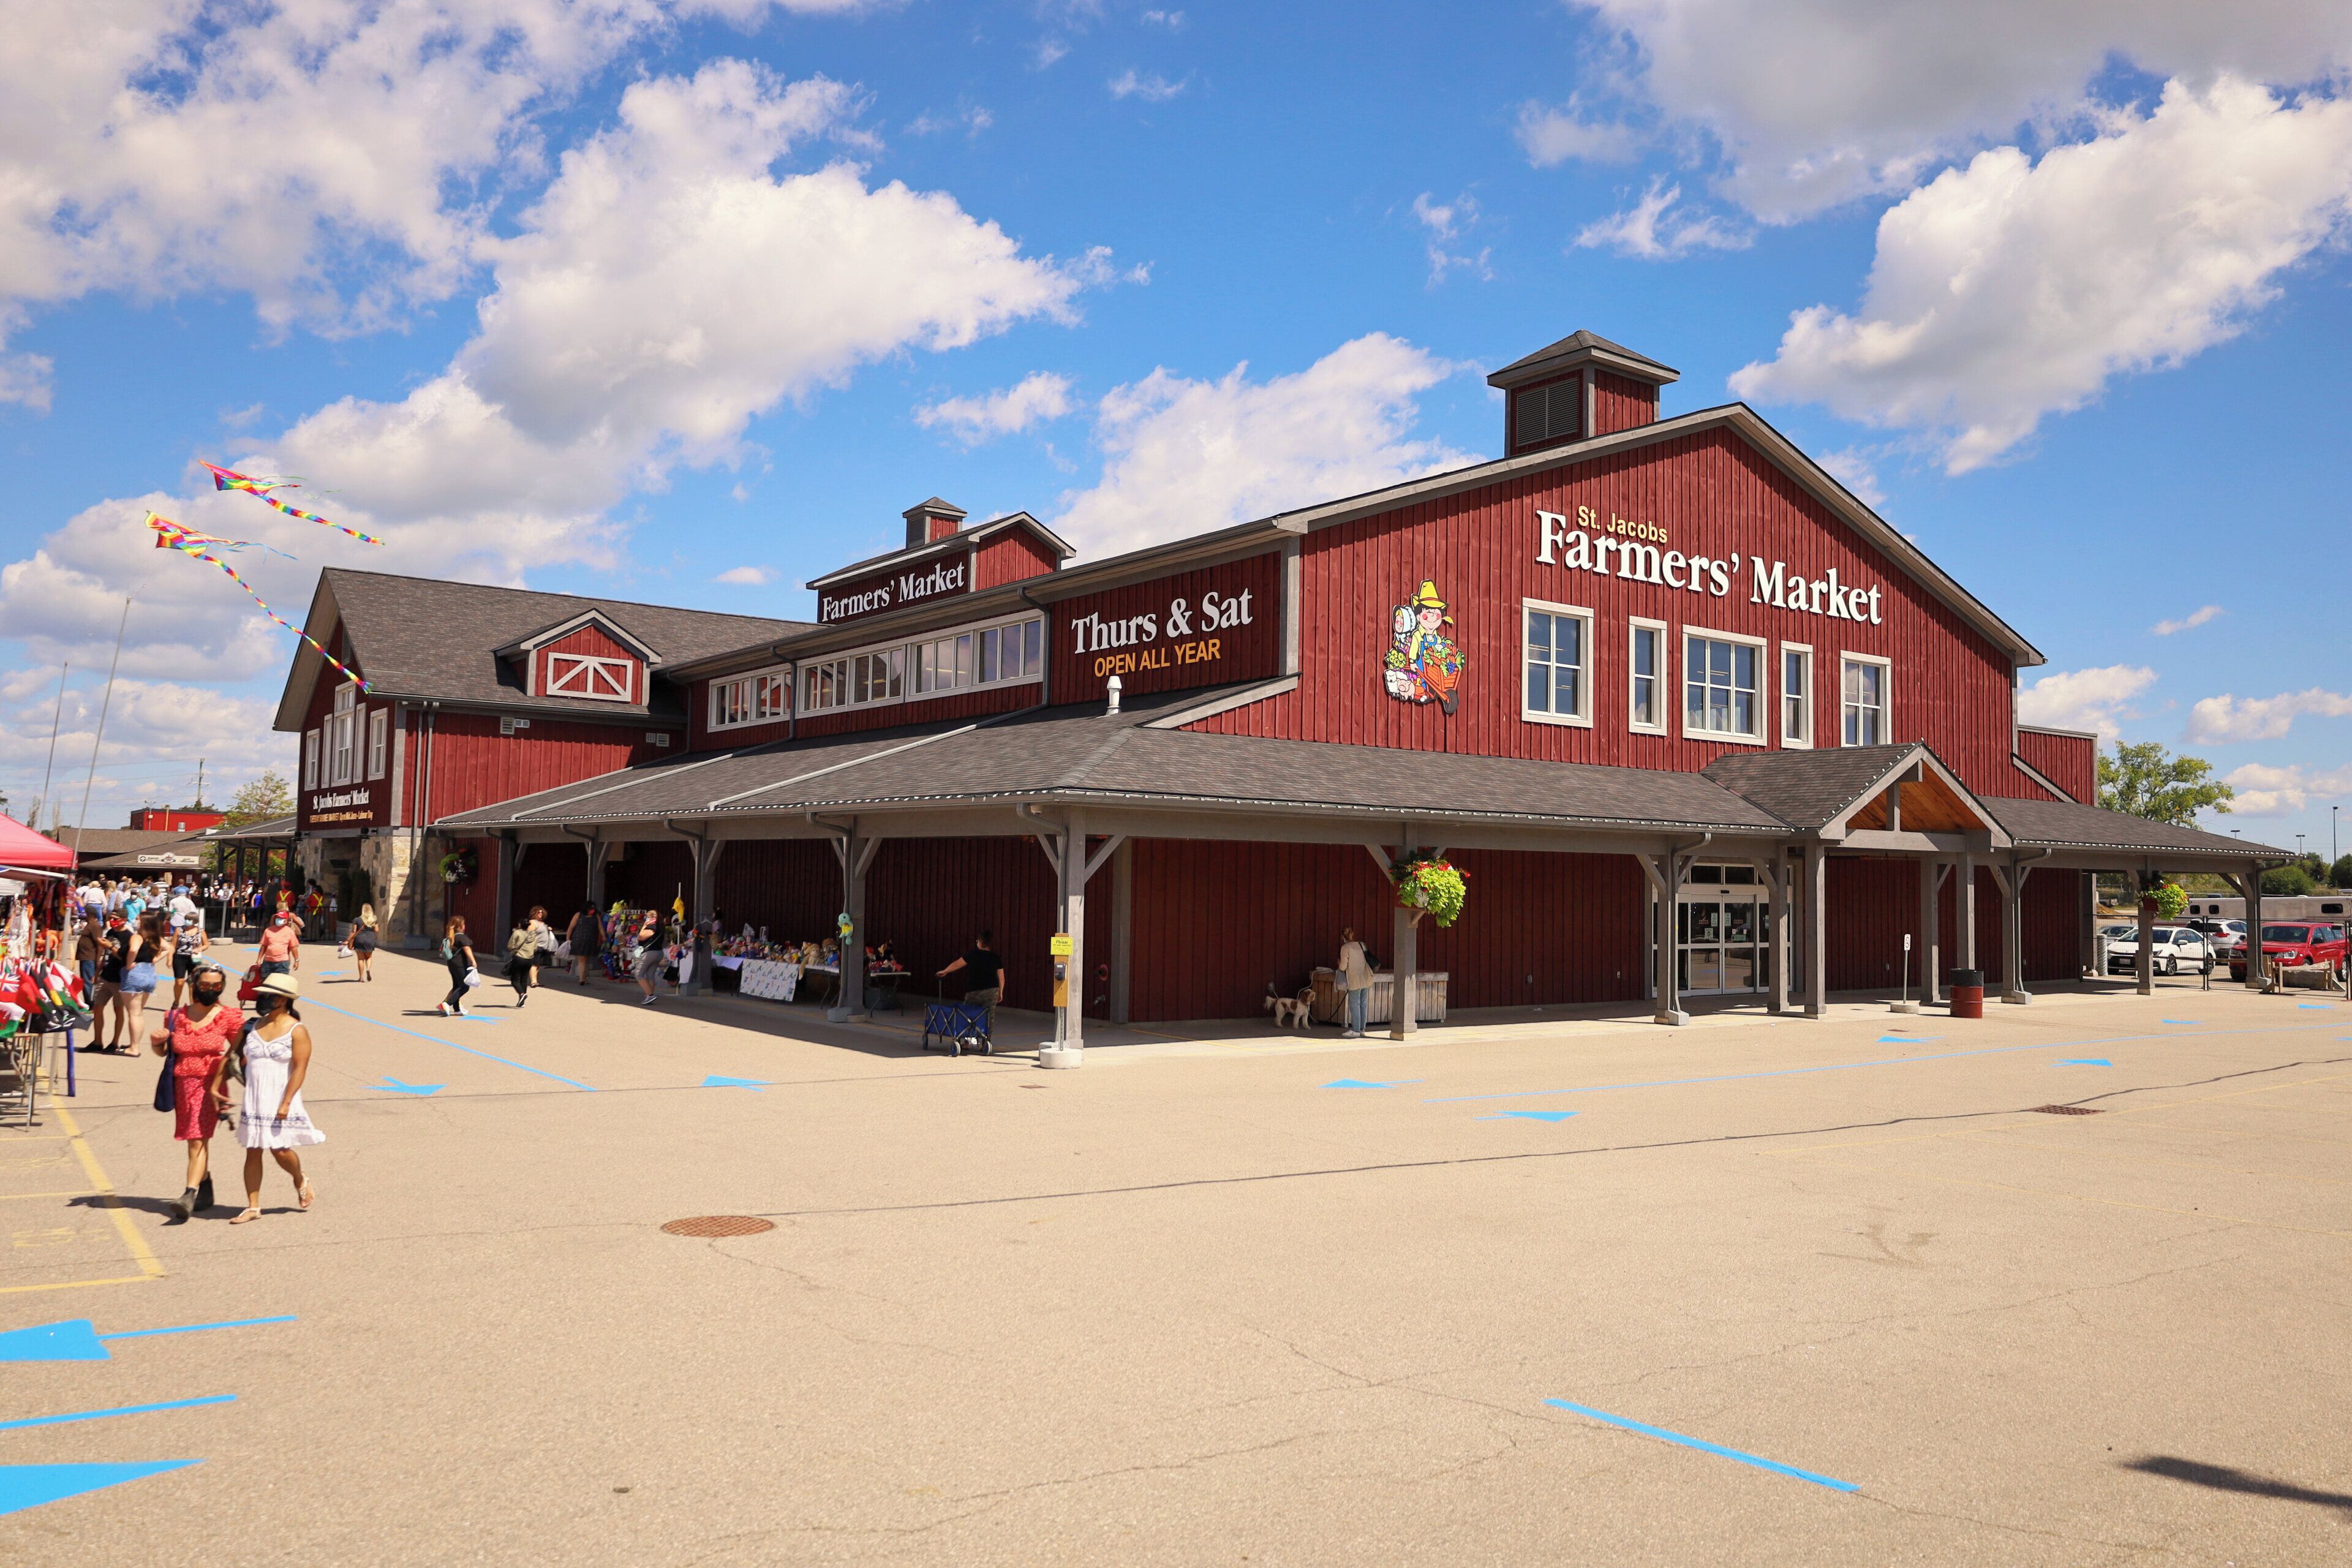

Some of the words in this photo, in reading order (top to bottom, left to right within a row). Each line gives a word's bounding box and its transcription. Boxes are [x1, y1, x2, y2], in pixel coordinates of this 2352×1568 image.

[1577, 505, 1600, 530] St.
[1607, 513, 1668, 543] Jacobs
[821, 579, 894, 622] Farmers'
[898, 562, 965, 603] Market
[1536, 510, 1740, 596] Farmers'
[1750, 556, 1882, 625] Market
[1071, 611, 1157, 654] Thurs
[1166, 598, 1193, 638] &
[1201, 587, 1253, 631] Sat
[1095, 652, 1136, 677] OPEN
[1139, 647, 1170, 671] ALL
[1174, 639, 1221, 665] YEAR
[352, 787, 369, 805] Market
